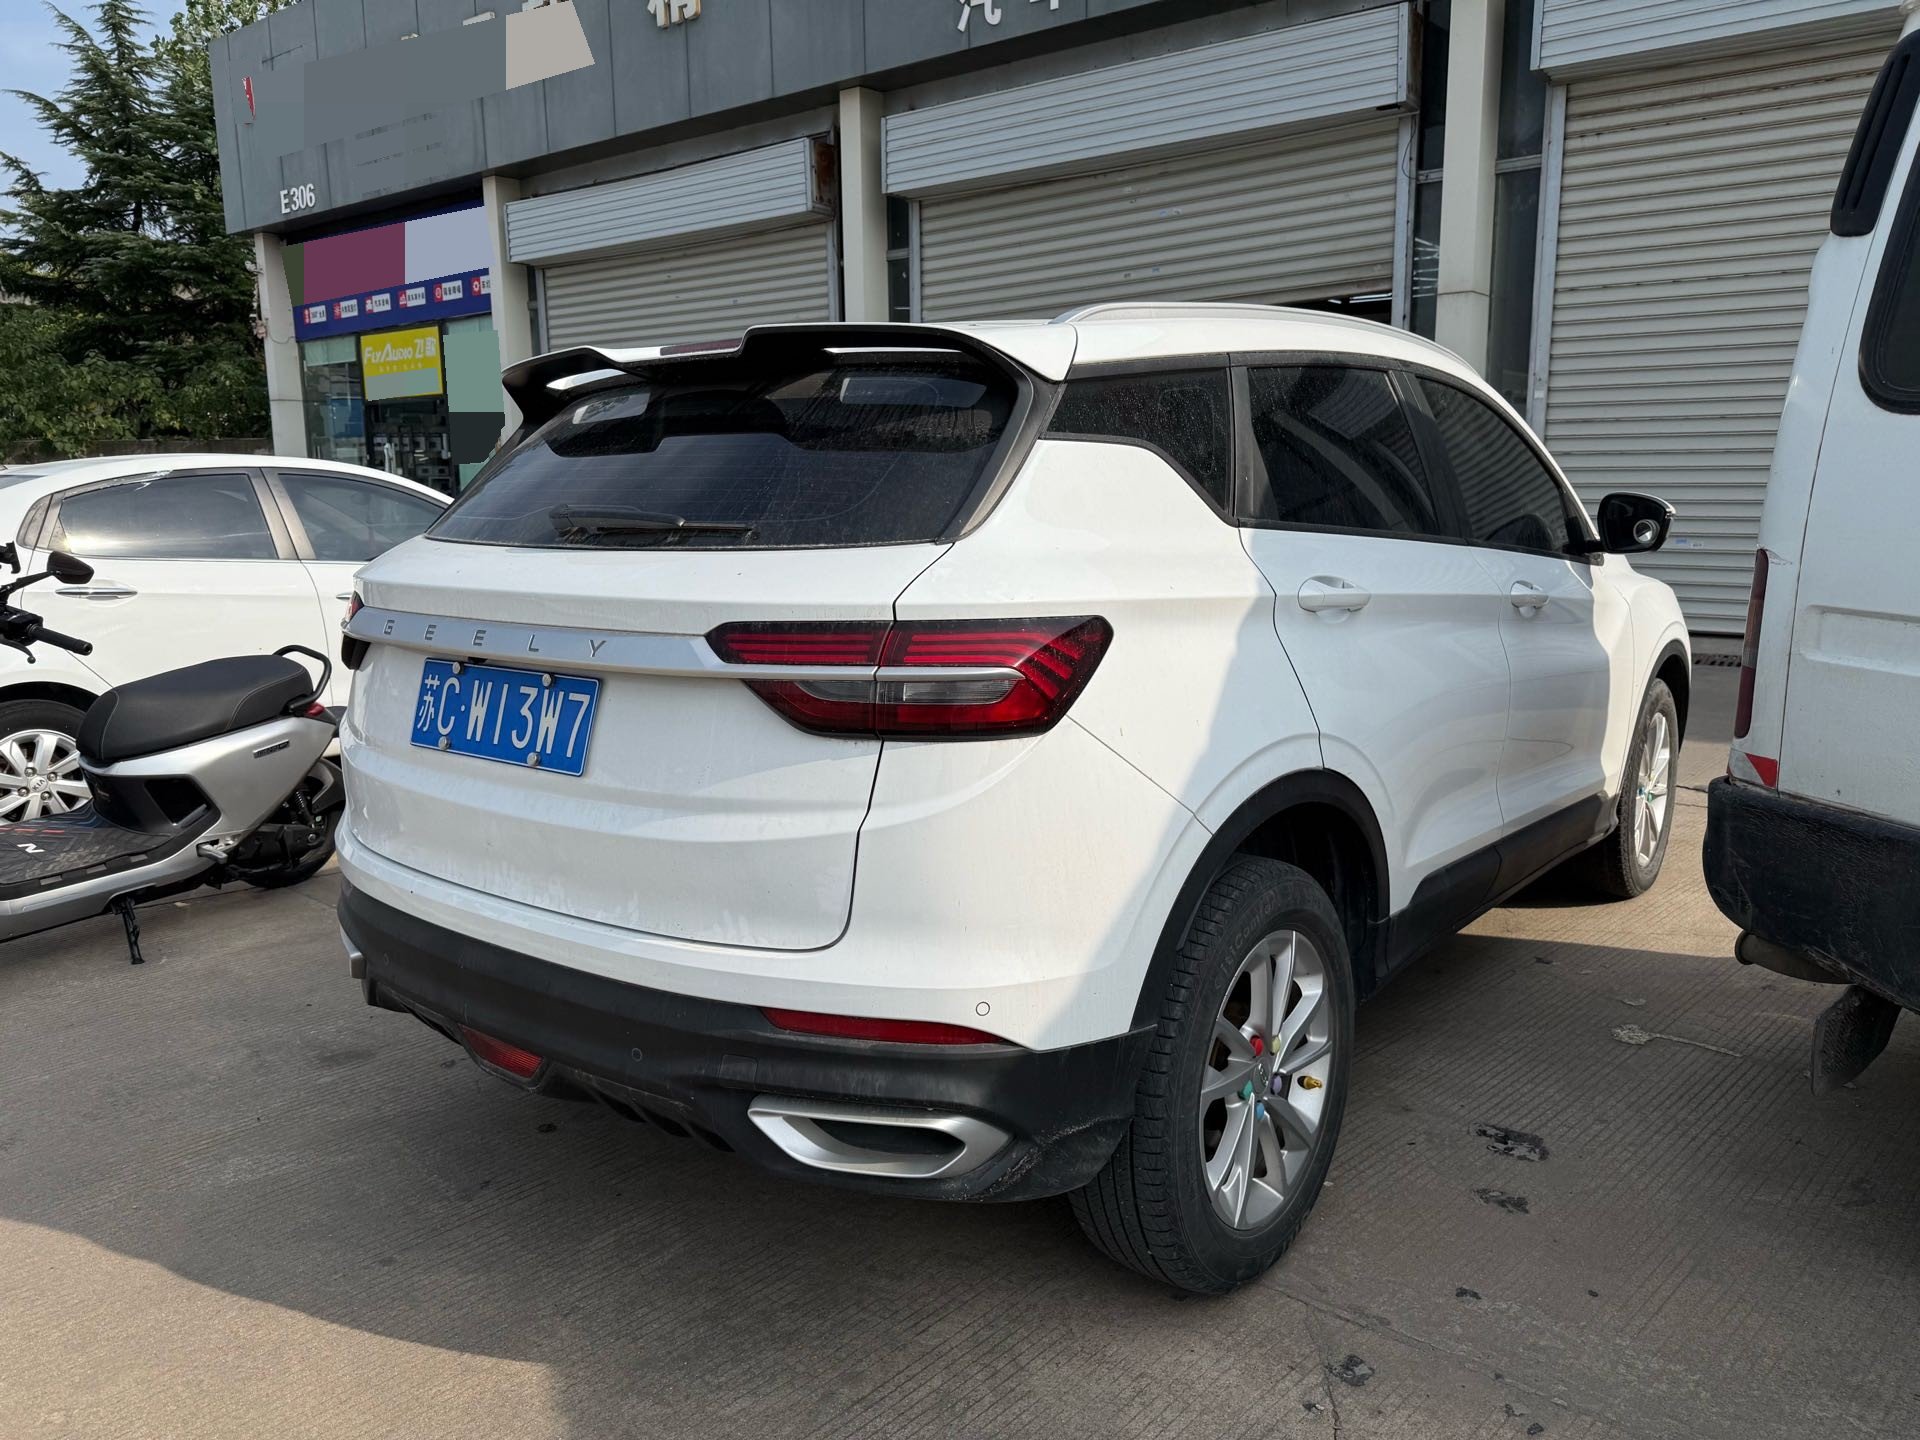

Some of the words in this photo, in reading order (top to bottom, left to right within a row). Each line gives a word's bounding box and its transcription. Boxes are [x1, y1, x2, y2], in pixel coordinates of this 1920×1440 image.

[279, 183, 316, 214] E306
[383, 619, 607, 658] GEELY
[31, 779, 46, 791] KIA
